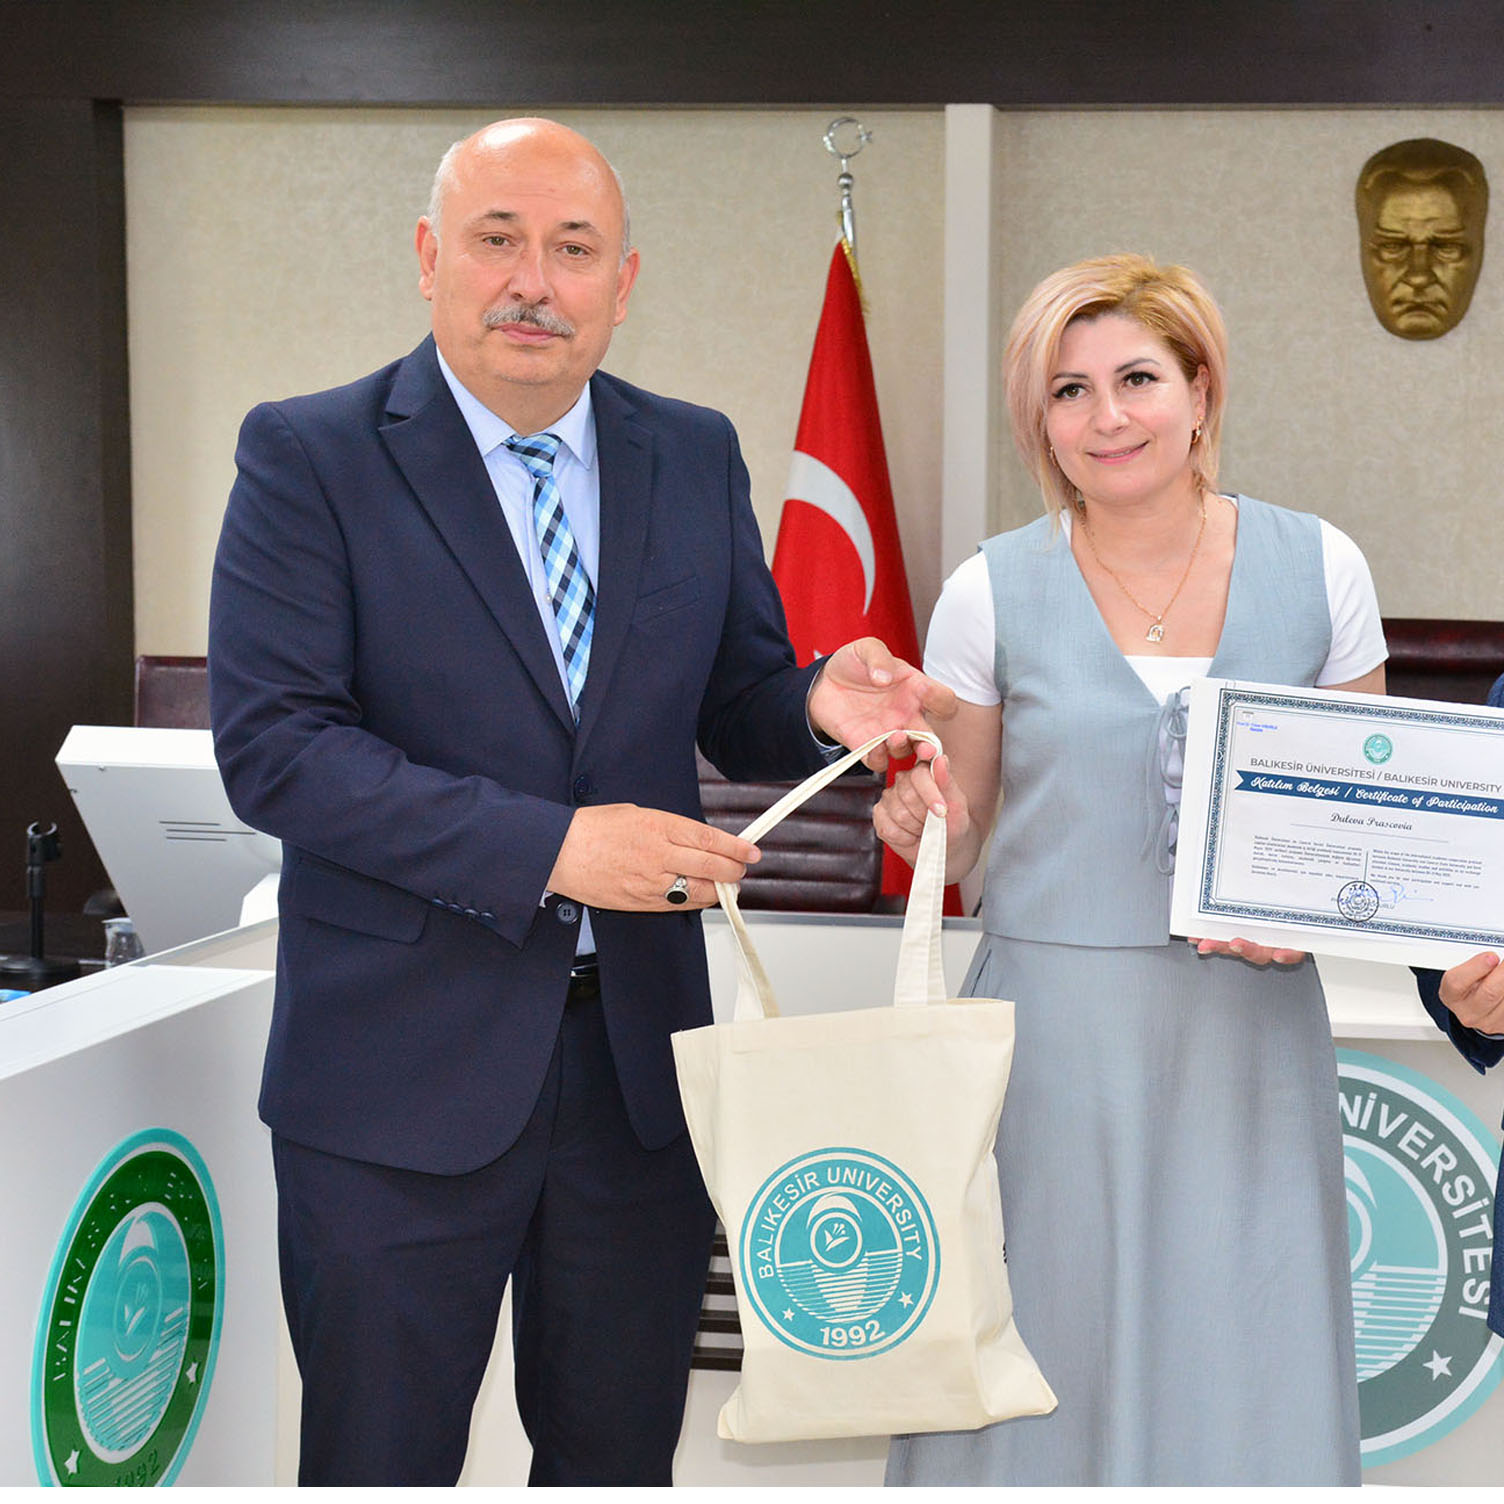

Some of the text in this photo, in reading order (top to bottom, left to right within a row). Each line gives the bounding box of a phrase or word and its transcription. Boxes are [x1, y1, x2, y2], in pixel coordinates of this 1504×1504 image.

[1296, 781, 1340, 798] Belgesi
[1355, 787, 1409, 804] Certificate
[1412, 795, 1424, 808] of
[1426, 796, 1499, 814] Participation
[1440, 778, 1502, 793] UNIVERSITY
[756, 1166, 923, 1279] BALIKESİR UNIVERSITY
[819, 1319, 886, 1347] 1992
